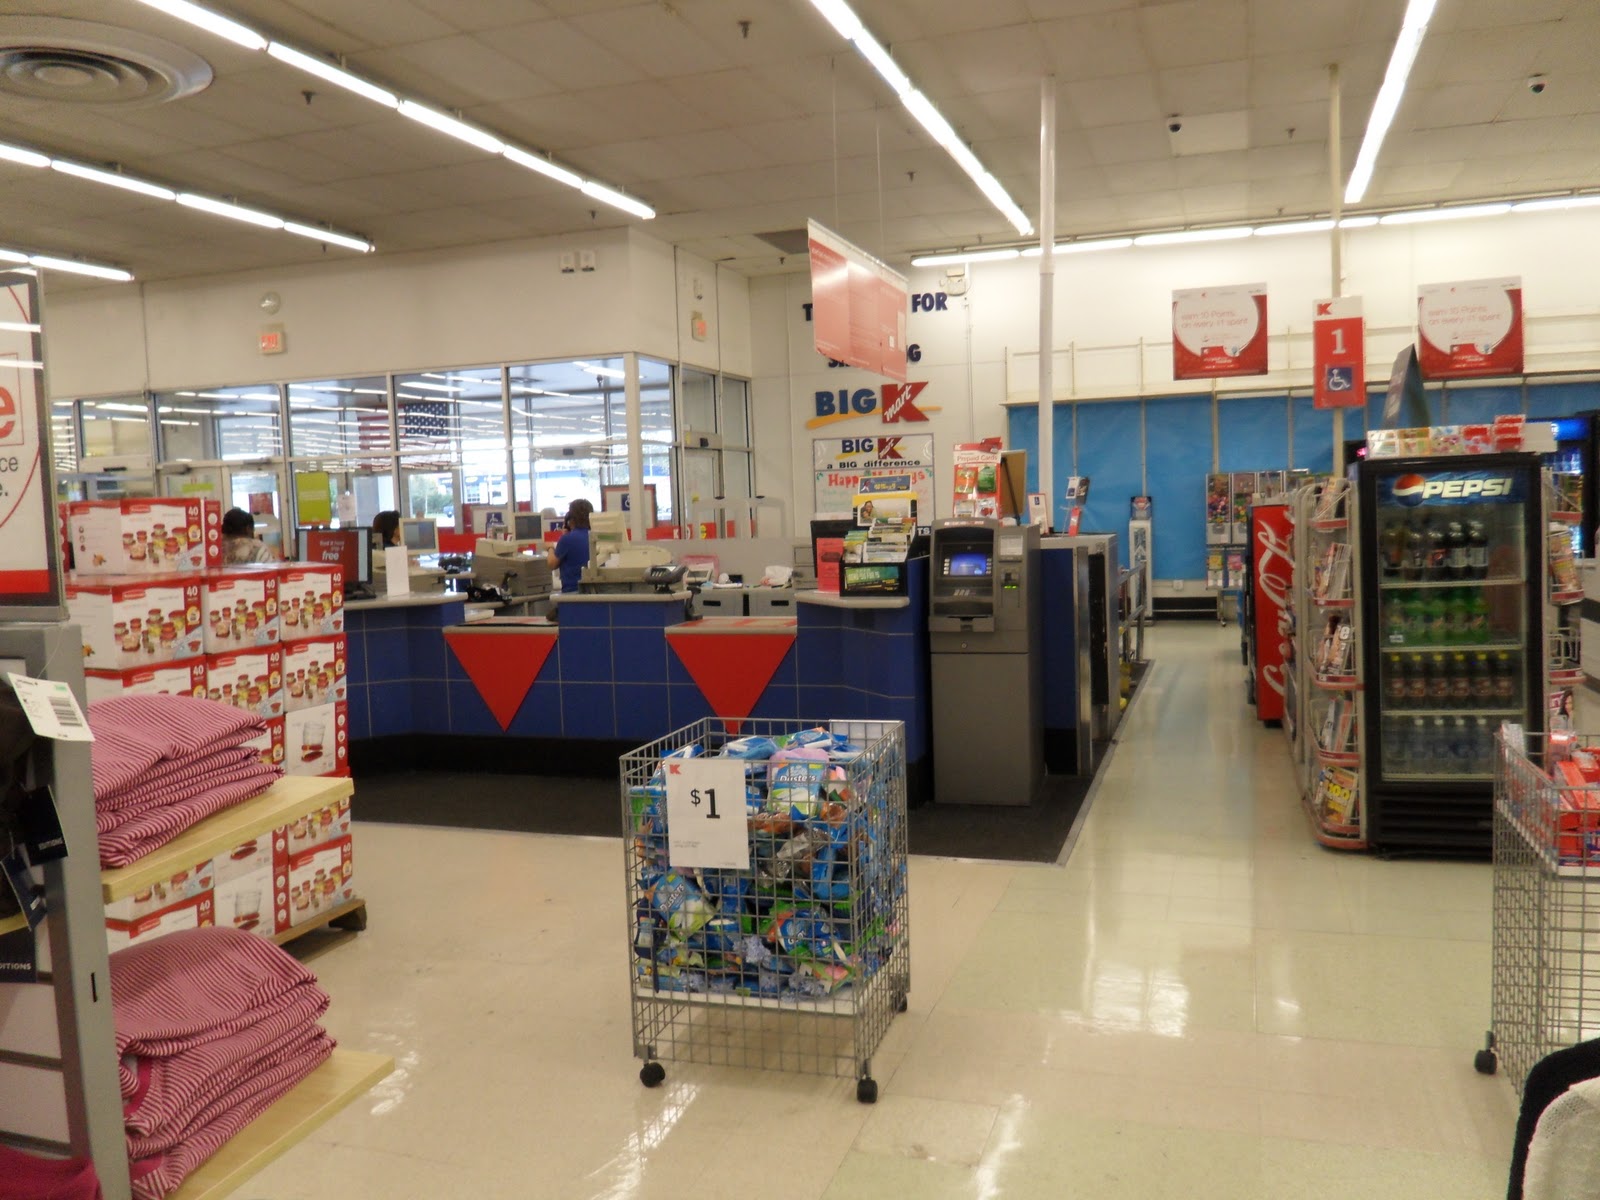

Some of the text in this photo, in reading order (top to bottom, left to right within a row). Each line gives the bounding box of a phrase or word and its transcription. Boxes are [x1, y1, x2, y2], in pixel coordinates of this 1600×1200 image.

[912, 292, 948, 313] FOR
[1331, 329, 1347, 355] 1
[815, 388, 877, 416] BIG
[841, 438, 874, 453] BIG
[956, 453, 998, 463] Prepaid Cards
[839, 461, 858, 469] BIG
[863, 460, 921, 468] difference
[828, 473, 859, 489] Happ
[1421, 478, 1514, 499] PEPSI
[188, 506, 199, 517] 40
[322, 550, 340, 561] free
[333, 573, 342, 583] 40
[266, 579, 276, 589] 40
[187, 586, 198, 597] 40
[336, 641, 345, 651] 40
[270, 652, 280, 662] 40
[193, 665, 204, 676] 40
[273, 725, 282, 735] 40
[690, 788, 721, 819] $1
[659, 884, 685, 913] Dusters
[200, 900, 211, 911] 40
